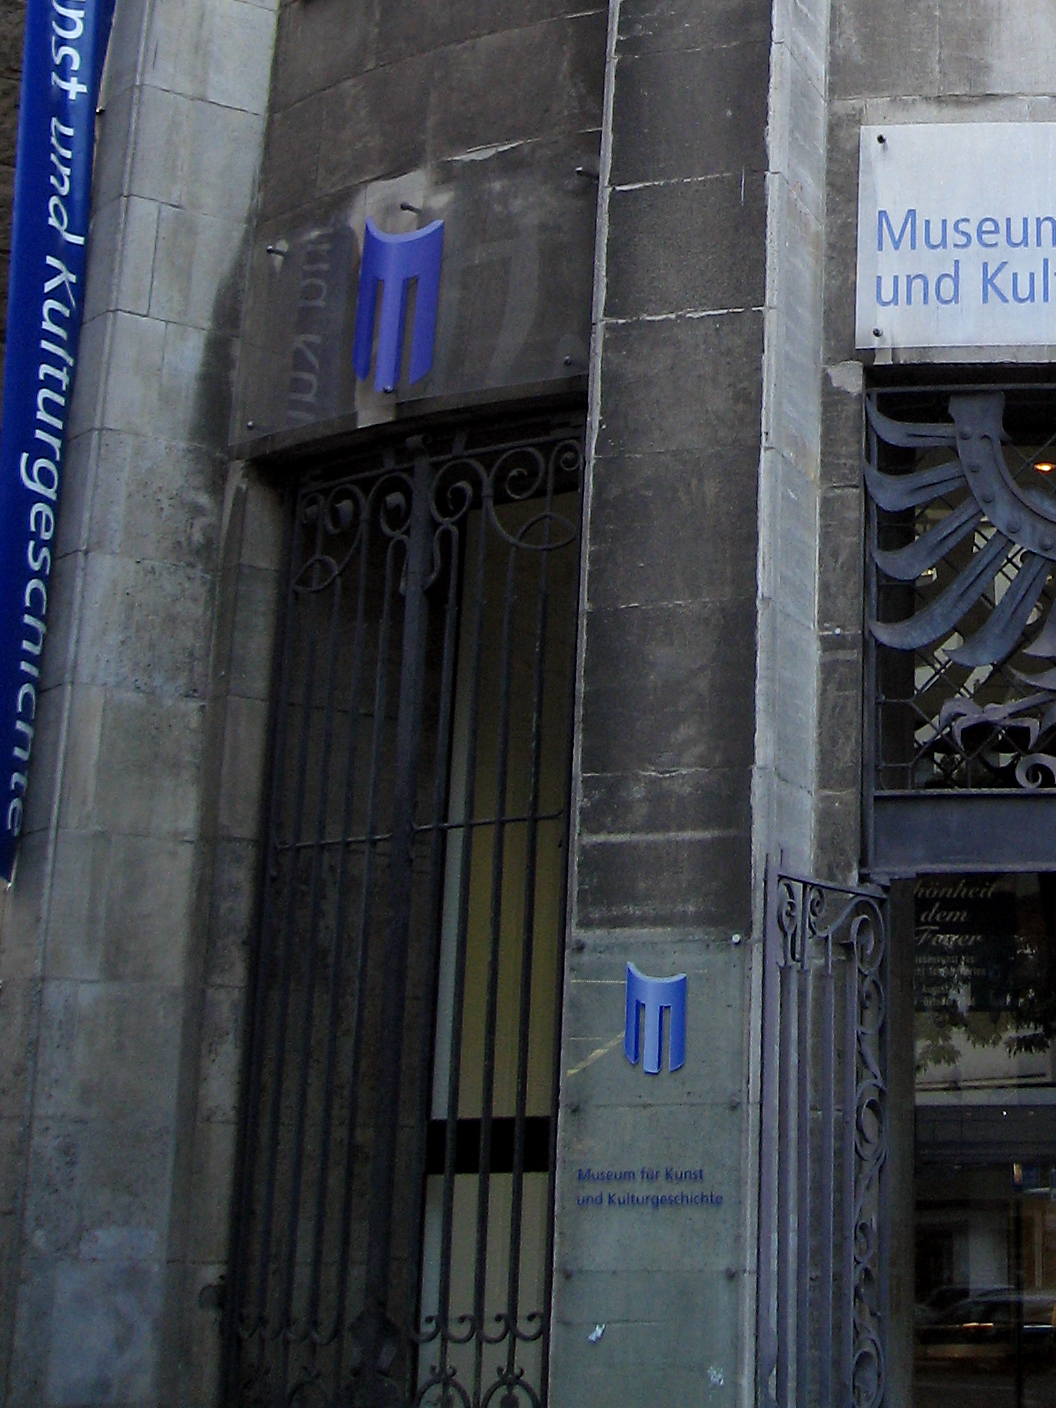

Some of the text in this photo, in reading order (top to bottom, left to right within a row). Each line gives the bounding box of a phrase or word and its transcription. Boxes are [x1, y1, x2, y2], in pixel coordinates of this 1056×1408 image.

[48, 116, 85, 245] und
[876, 259, 960, 307] und
[7, 255, 77, 836] Kulturgeschichte
[577, 1167, 636, 1182] Museum
[665, 1167, 704, 1182] Kunst
[577, 1192, 724, 1209] und Kulturgeschichte
